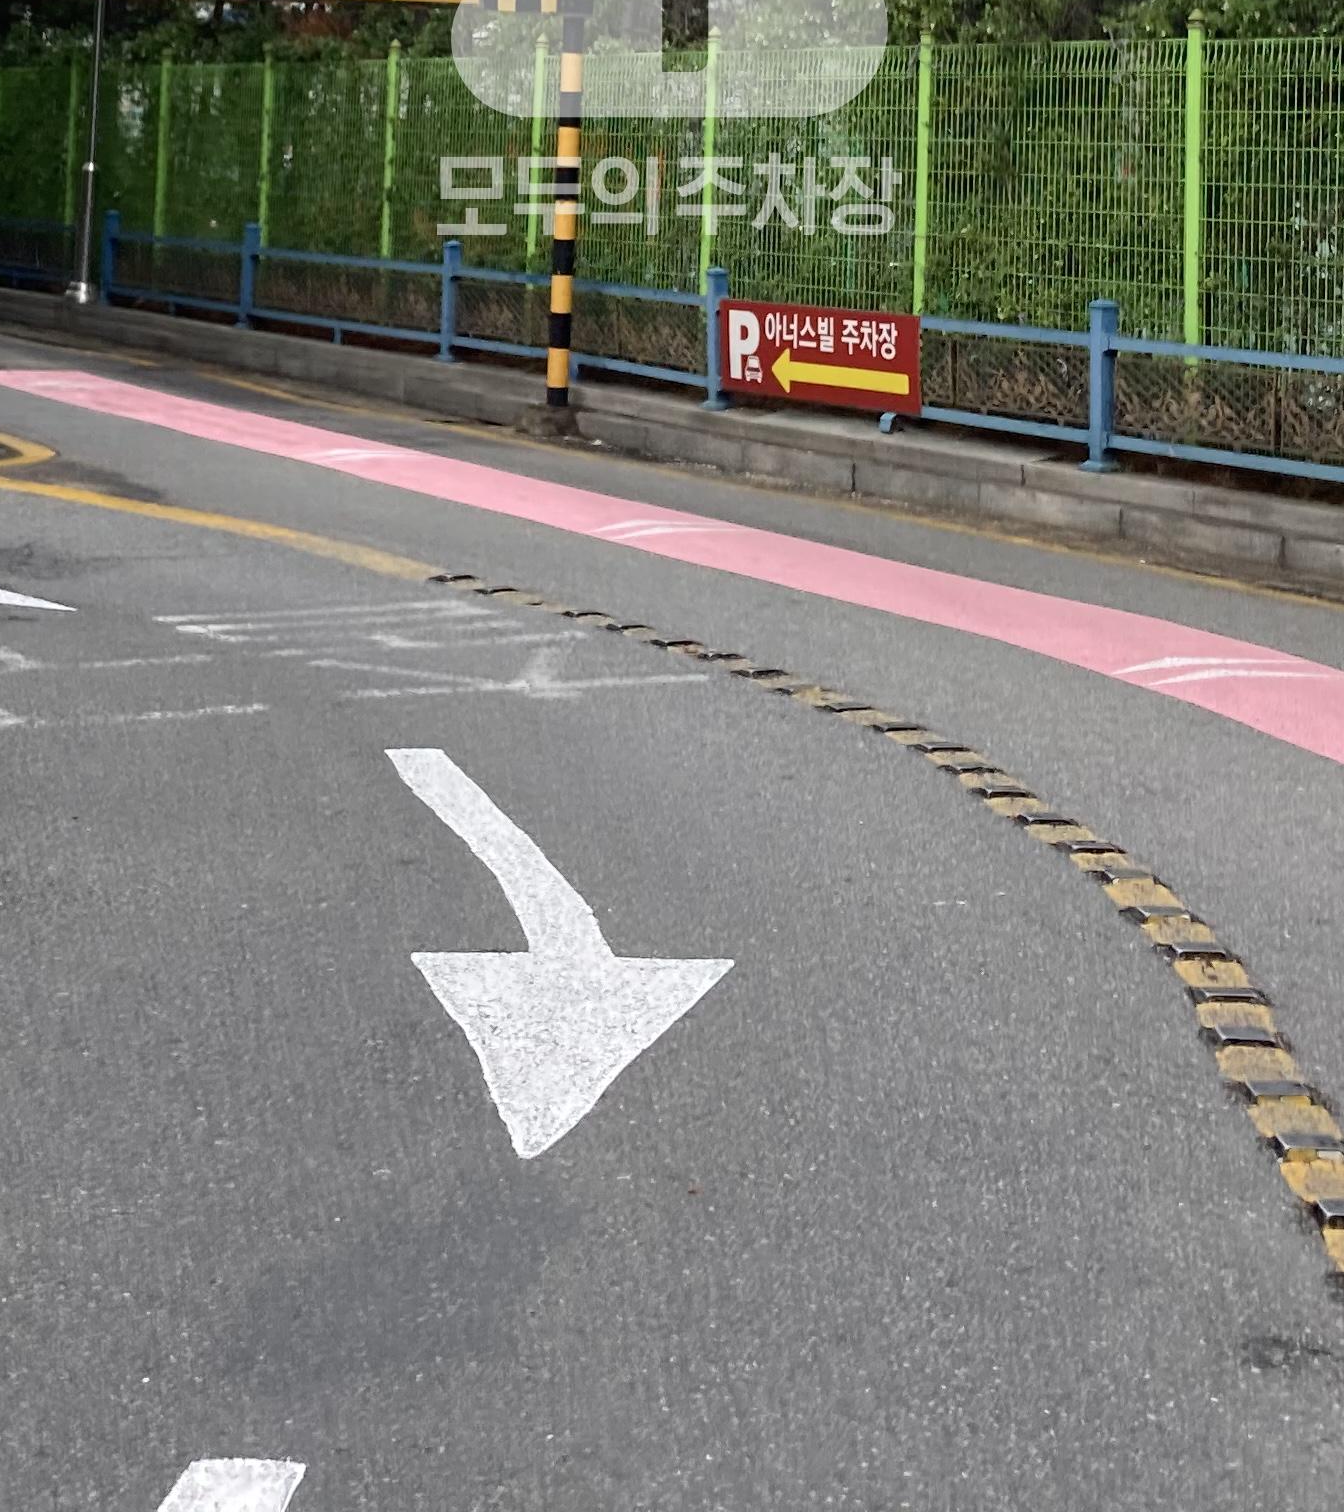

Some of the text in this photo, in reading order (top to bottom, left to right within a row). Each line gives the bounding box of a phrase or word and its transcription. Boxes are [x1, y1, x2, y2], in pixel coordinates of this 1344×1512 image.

[728, 309, 761, 380] P
[765, 312, 898, 361] 아너스빌 주차장
